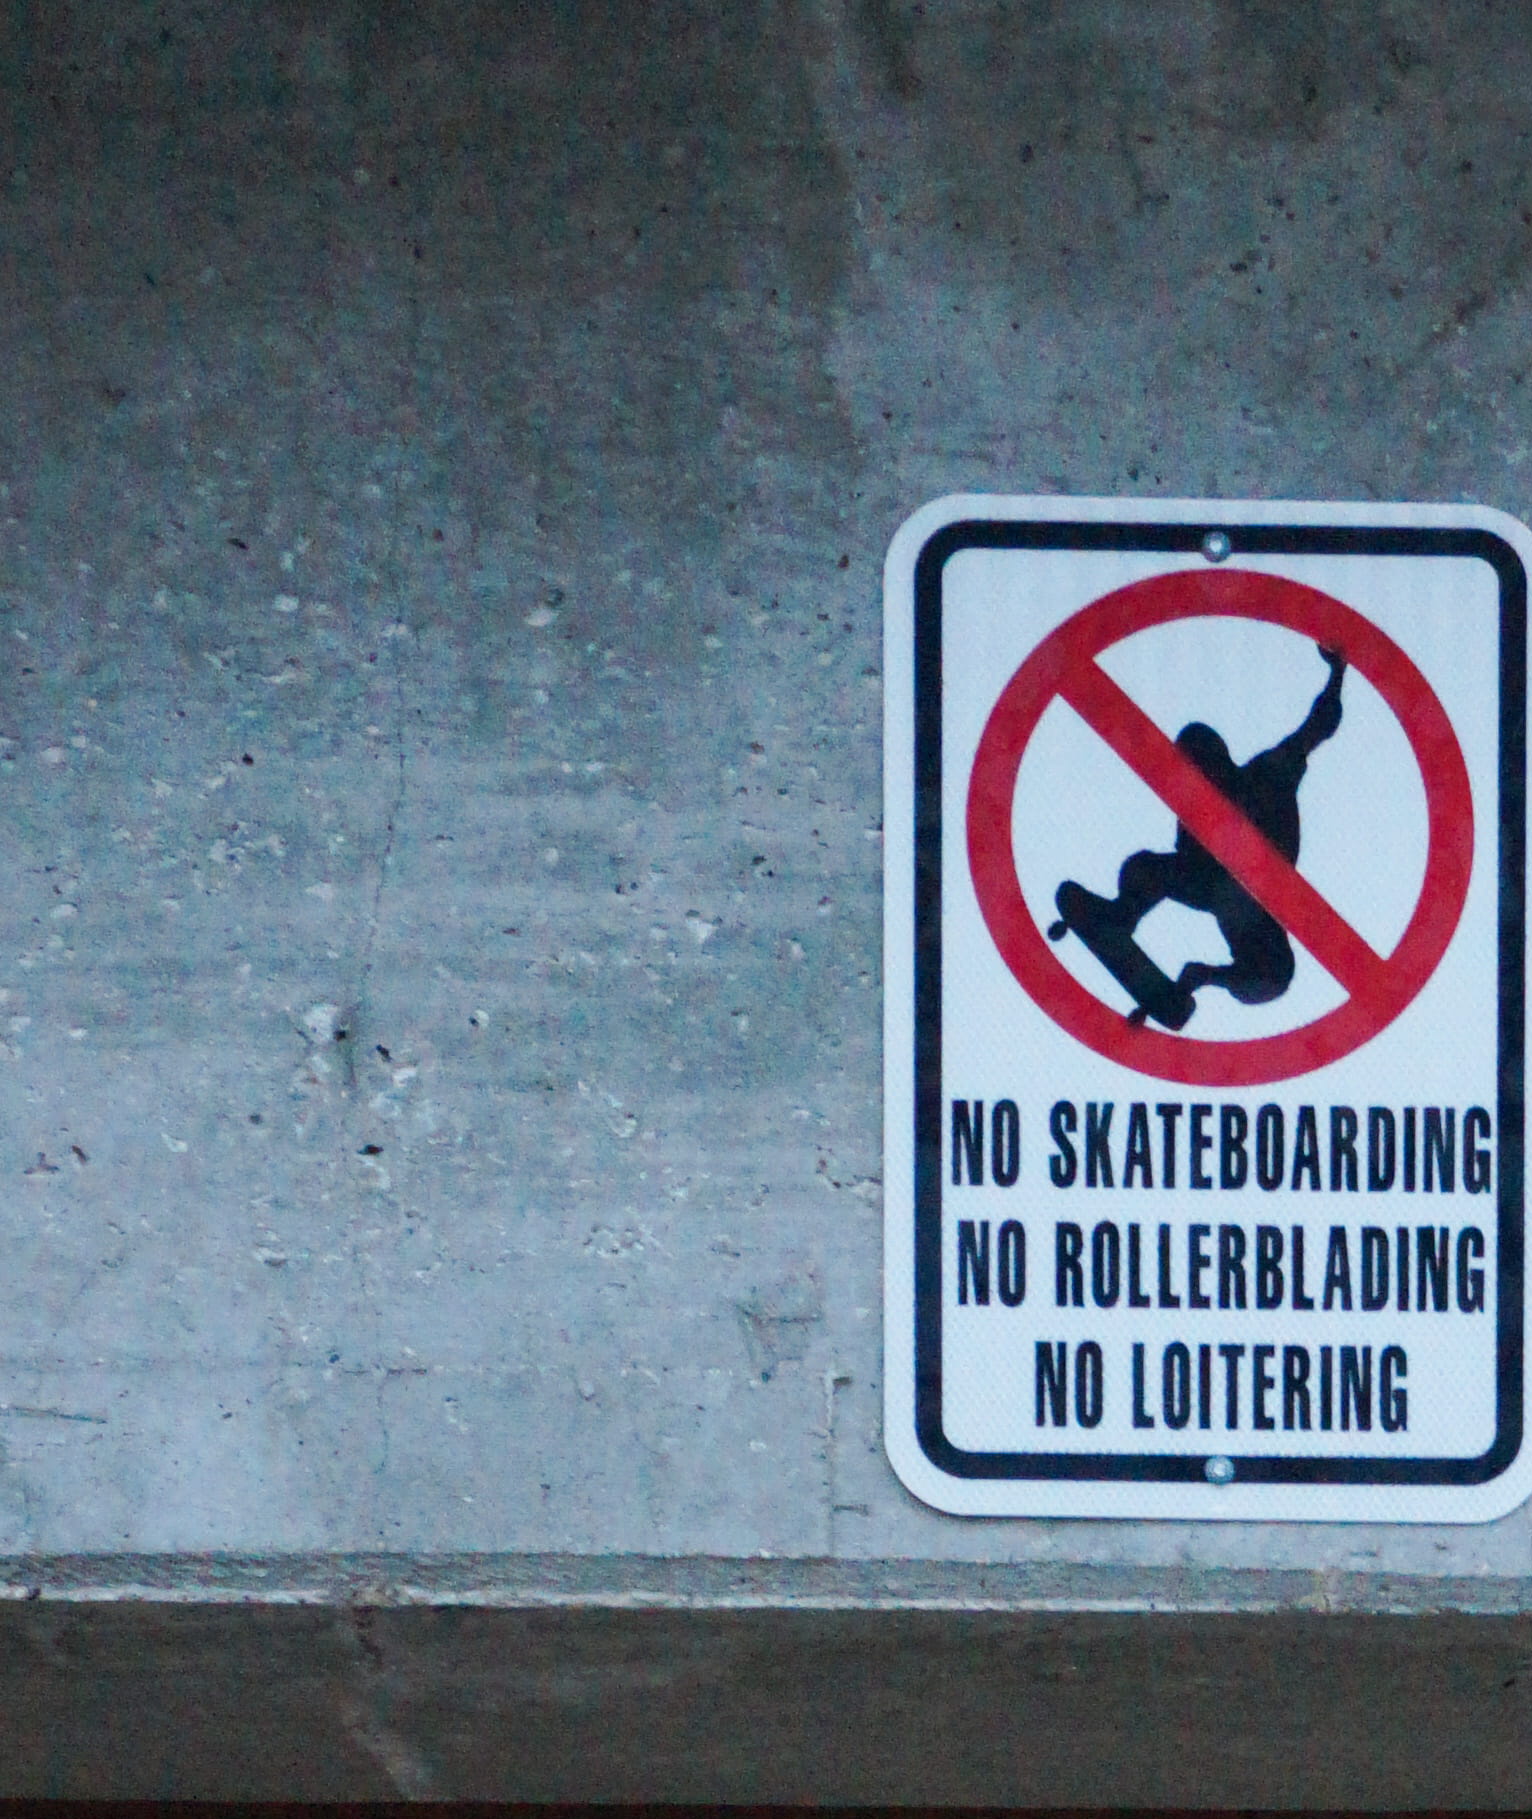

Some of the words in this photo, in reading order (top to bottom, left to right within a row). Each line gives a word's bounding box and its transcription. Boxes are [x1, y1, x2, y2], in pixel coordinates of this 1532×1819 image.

[951, 1099, 1020, 1188] NO
[1048, 1099, 1492, 1195] SKATEBOARDING
[957, 1218, 1026, 1308] NO
[1054, 1219, 1485, 1314] ROLLERBLADING
[1034, 1339, 1103, 1429] NO
[1131, 1340, 1409, 1433] LOITERING
